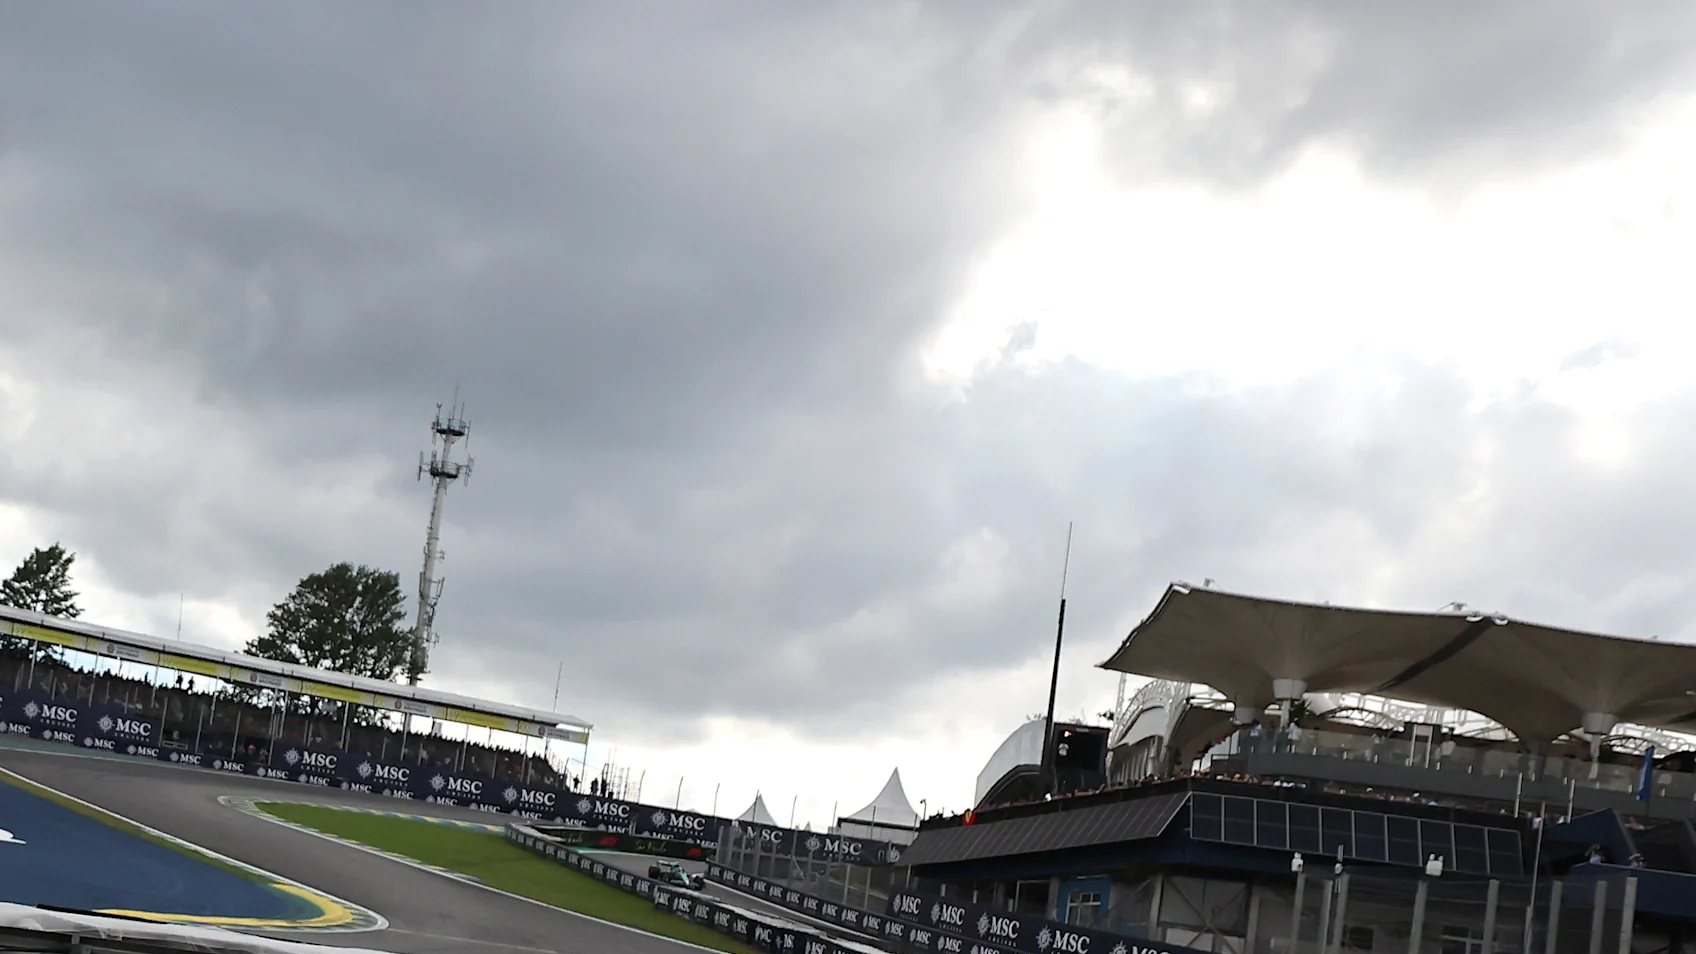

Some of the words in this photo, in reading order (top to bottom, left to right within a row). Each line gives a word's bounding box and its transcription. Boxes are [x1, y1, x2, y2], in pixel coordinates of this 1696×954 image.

[41, 704, 78, 723] MSC
[8, 723, 31, 735] MSC
[115, 718, 152, 736] MSC
[53, 731, 75, 742] MSC
[93, 738, 115, 750] MSC
[137, 746, 159, 757] MSC
[179, 753, 201, 765] MSC
[223, 760, 245, 772] MSC
[301, 751, 338, 769] MSC
[267, 768, 289, 780] MSC
[374, 764, 410, 781] MSC
[308, 774, 331, 787] MSC
[350, 782, 372, 793] MSC
[447, 776, 483, 795] MSC
[392, 789, 414, 800] MSC
[520, 789, 556, 806] MSC
[436, 797, 458, 807] MSC
[478, 804, 501, 813] MSC
[521, 811, 543, 821] MSC
[594, 801, 630, 818] MSC
[564, 817, 586, 828] MSC
[669, 813, 705, 831] MSC
[824, 838, 862, 855] MSC
[901, 895, 921, 915] MSC
[940, 904, 966, 925] MSC
[990, 916, 1020, 938] MSC
[915, 930, 931, 944] MSC
[1054, 929, 1091, 954] MSC
[944, 937, 962, 952] MSC
